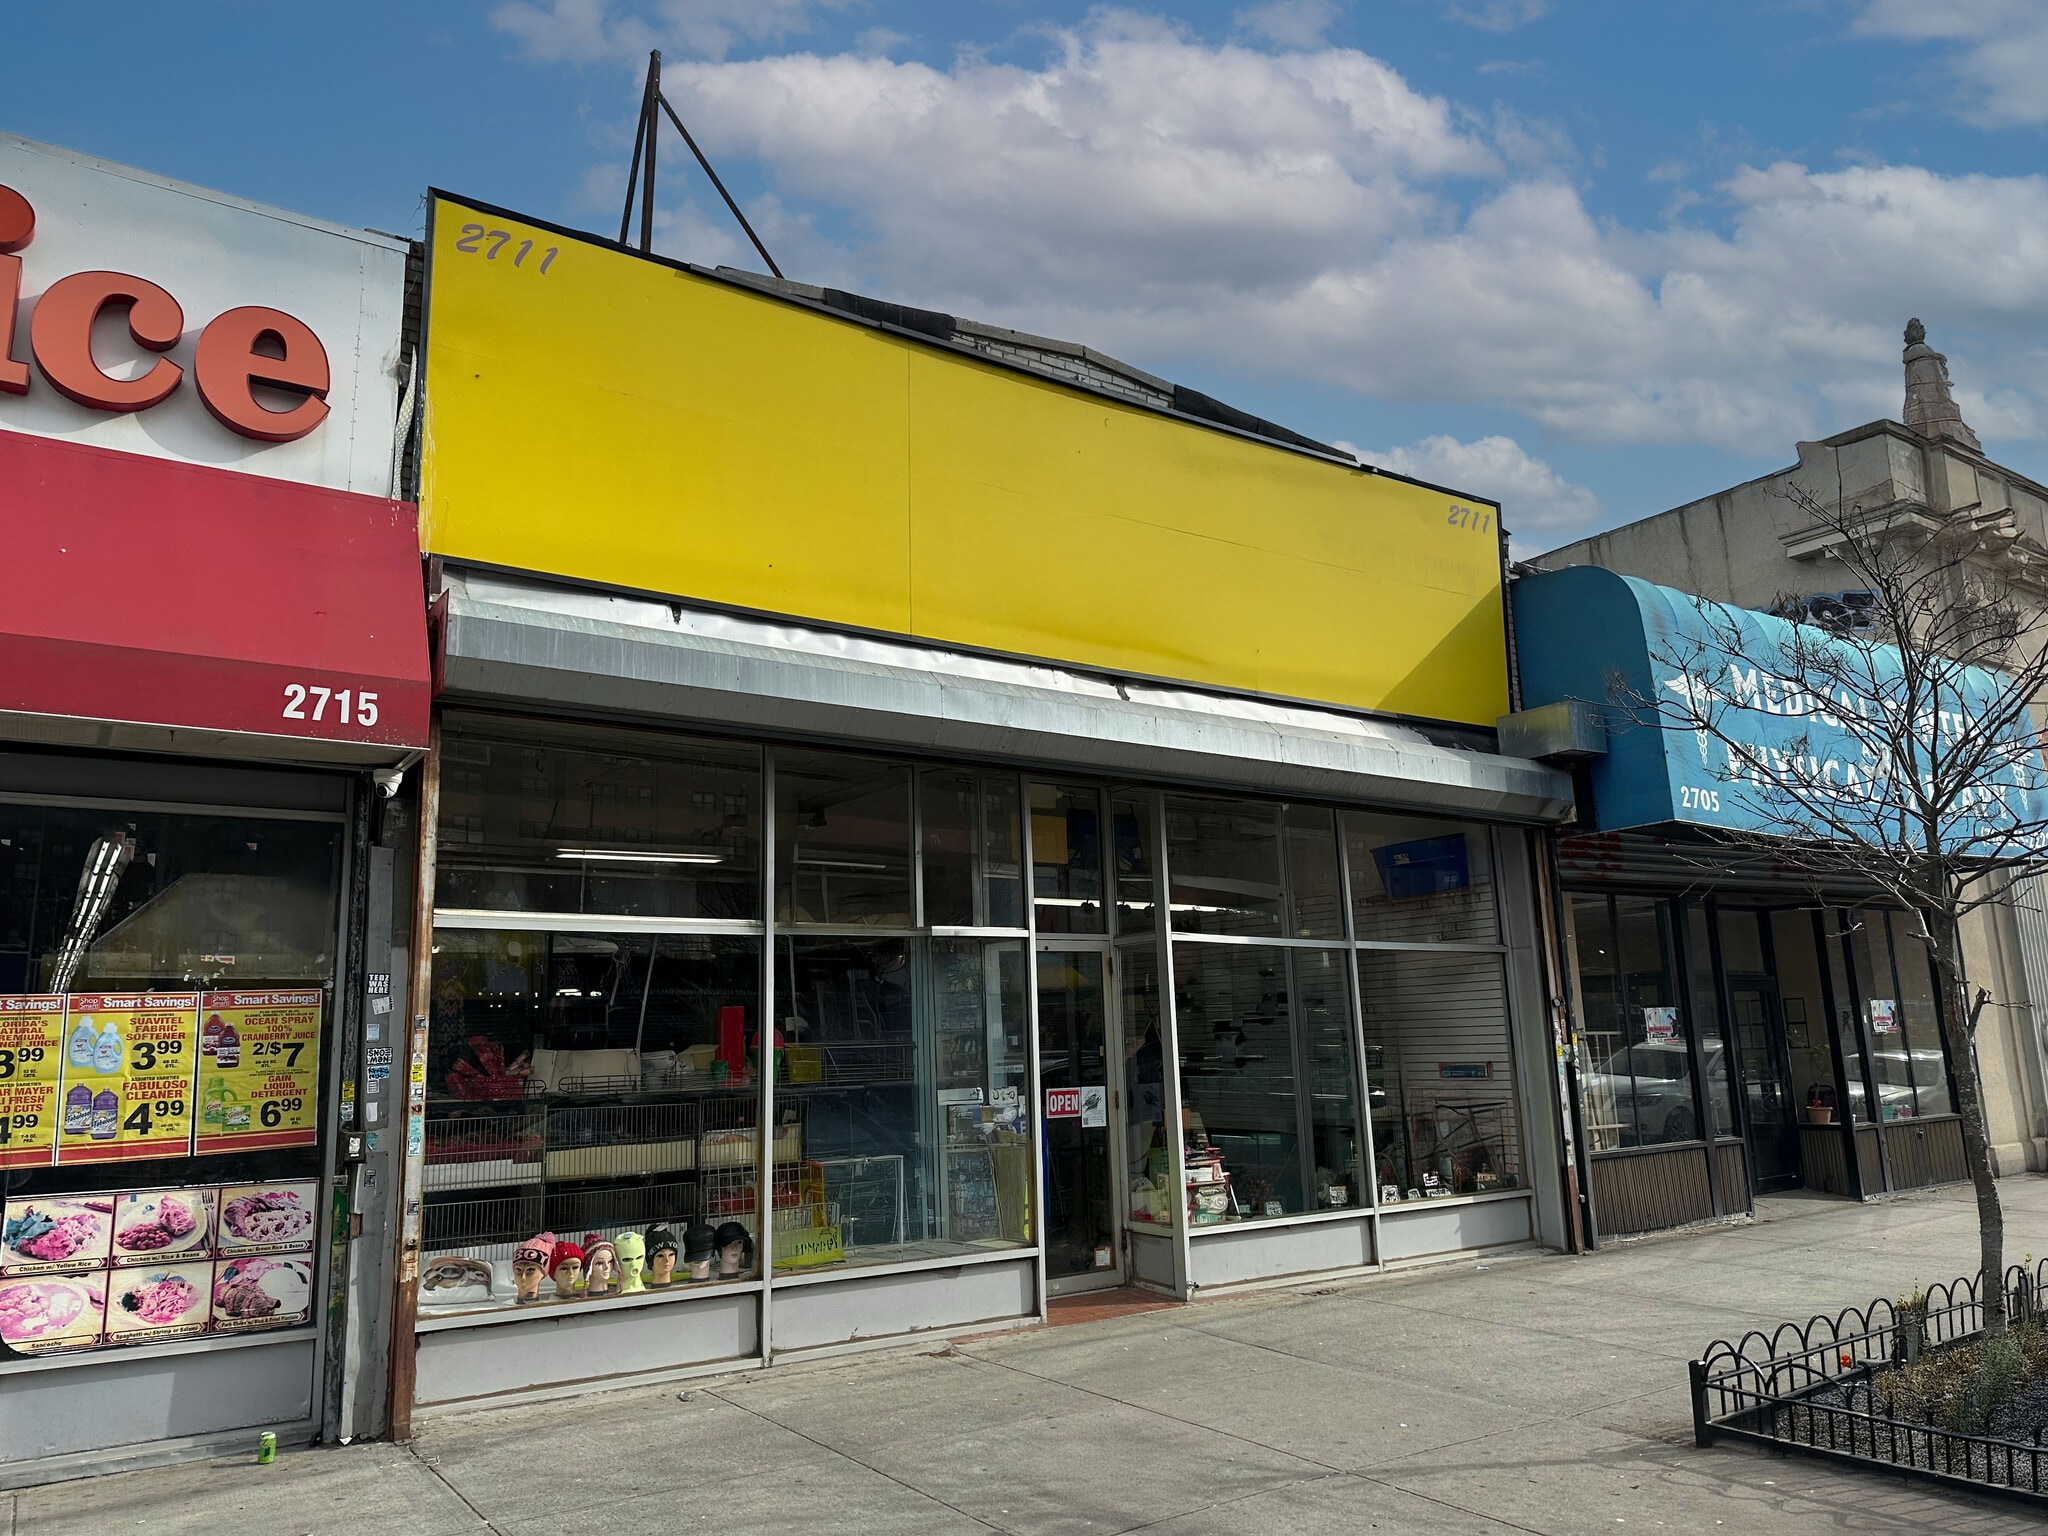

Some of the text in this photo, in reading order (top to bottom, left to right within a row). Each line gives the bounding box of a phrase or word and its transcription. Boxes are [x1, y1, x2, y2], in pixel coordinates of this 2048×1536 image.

[456, 223, 558, 276] 2711
[1447, 504, 1490, 535] 2711
[282, 683, 379, 727] 2715
[1680, 785, 1720, 813] 2705
[103, 996, 195, 1009] Smart Savings!
[234, 993, 318, 1004] Smart Savings!
[6, 999, 60, 1011] Savings!
[130, 1017, 184, 1025] SUAVITEL
[245, 1016, 314, 1025] OCEAN SPRAY
[135, 1024, 178, 1033] FABRIC
[126, 1032, 186, 1041] SOFTENER
[242, 1031, 316, 1041] CRANBERRY JUICE
[123, 1080, 188, 1091] FABULOSO
[264, 1081, 296, 1090] LIQUID
[15, 1087, 53, 1096] MAYER
[126, 1090, 183, 1100] CLEANER
[251, 1089, 308, 1099] DETERGENT
[9, 1096, 45, 1105] FRESH
[1049, 1094, 1079, 1113] OPEN
[14, 1104, 43, 1113] CUTS
[648, 1241, 665, 1256] NEW
[513, 1249, 549, 1267] BOY
[116, 1331, 143, 1339] Spaghetti
[153, 1328, 172, 1336] Shrimp
[31, 1341, 62, 1349] Sancocho
